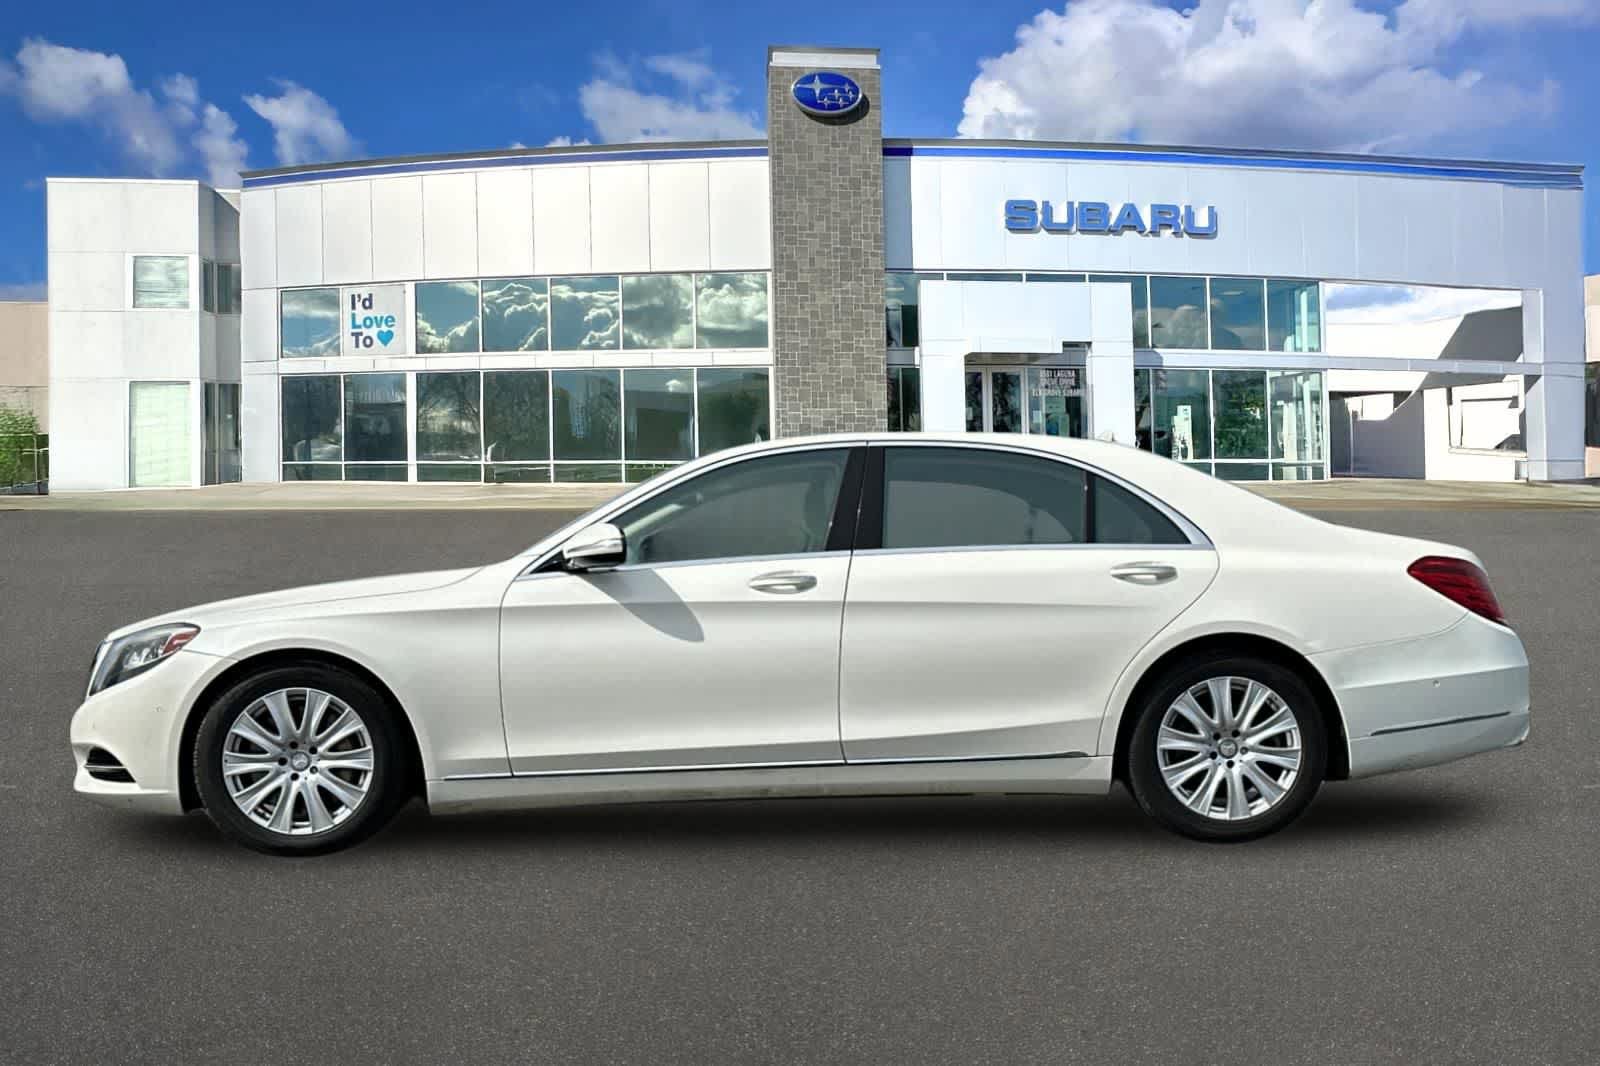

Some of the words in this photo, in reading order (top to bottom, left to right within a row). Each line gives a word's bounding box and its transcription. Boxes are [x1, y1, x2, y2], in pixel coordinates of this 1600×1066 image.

[1005, 199, 1216, 237] SUBARU
[351, 293, 373, 310] I'd
[351, 312, 396, 329] Love
[351, 331, 374, 348] To
